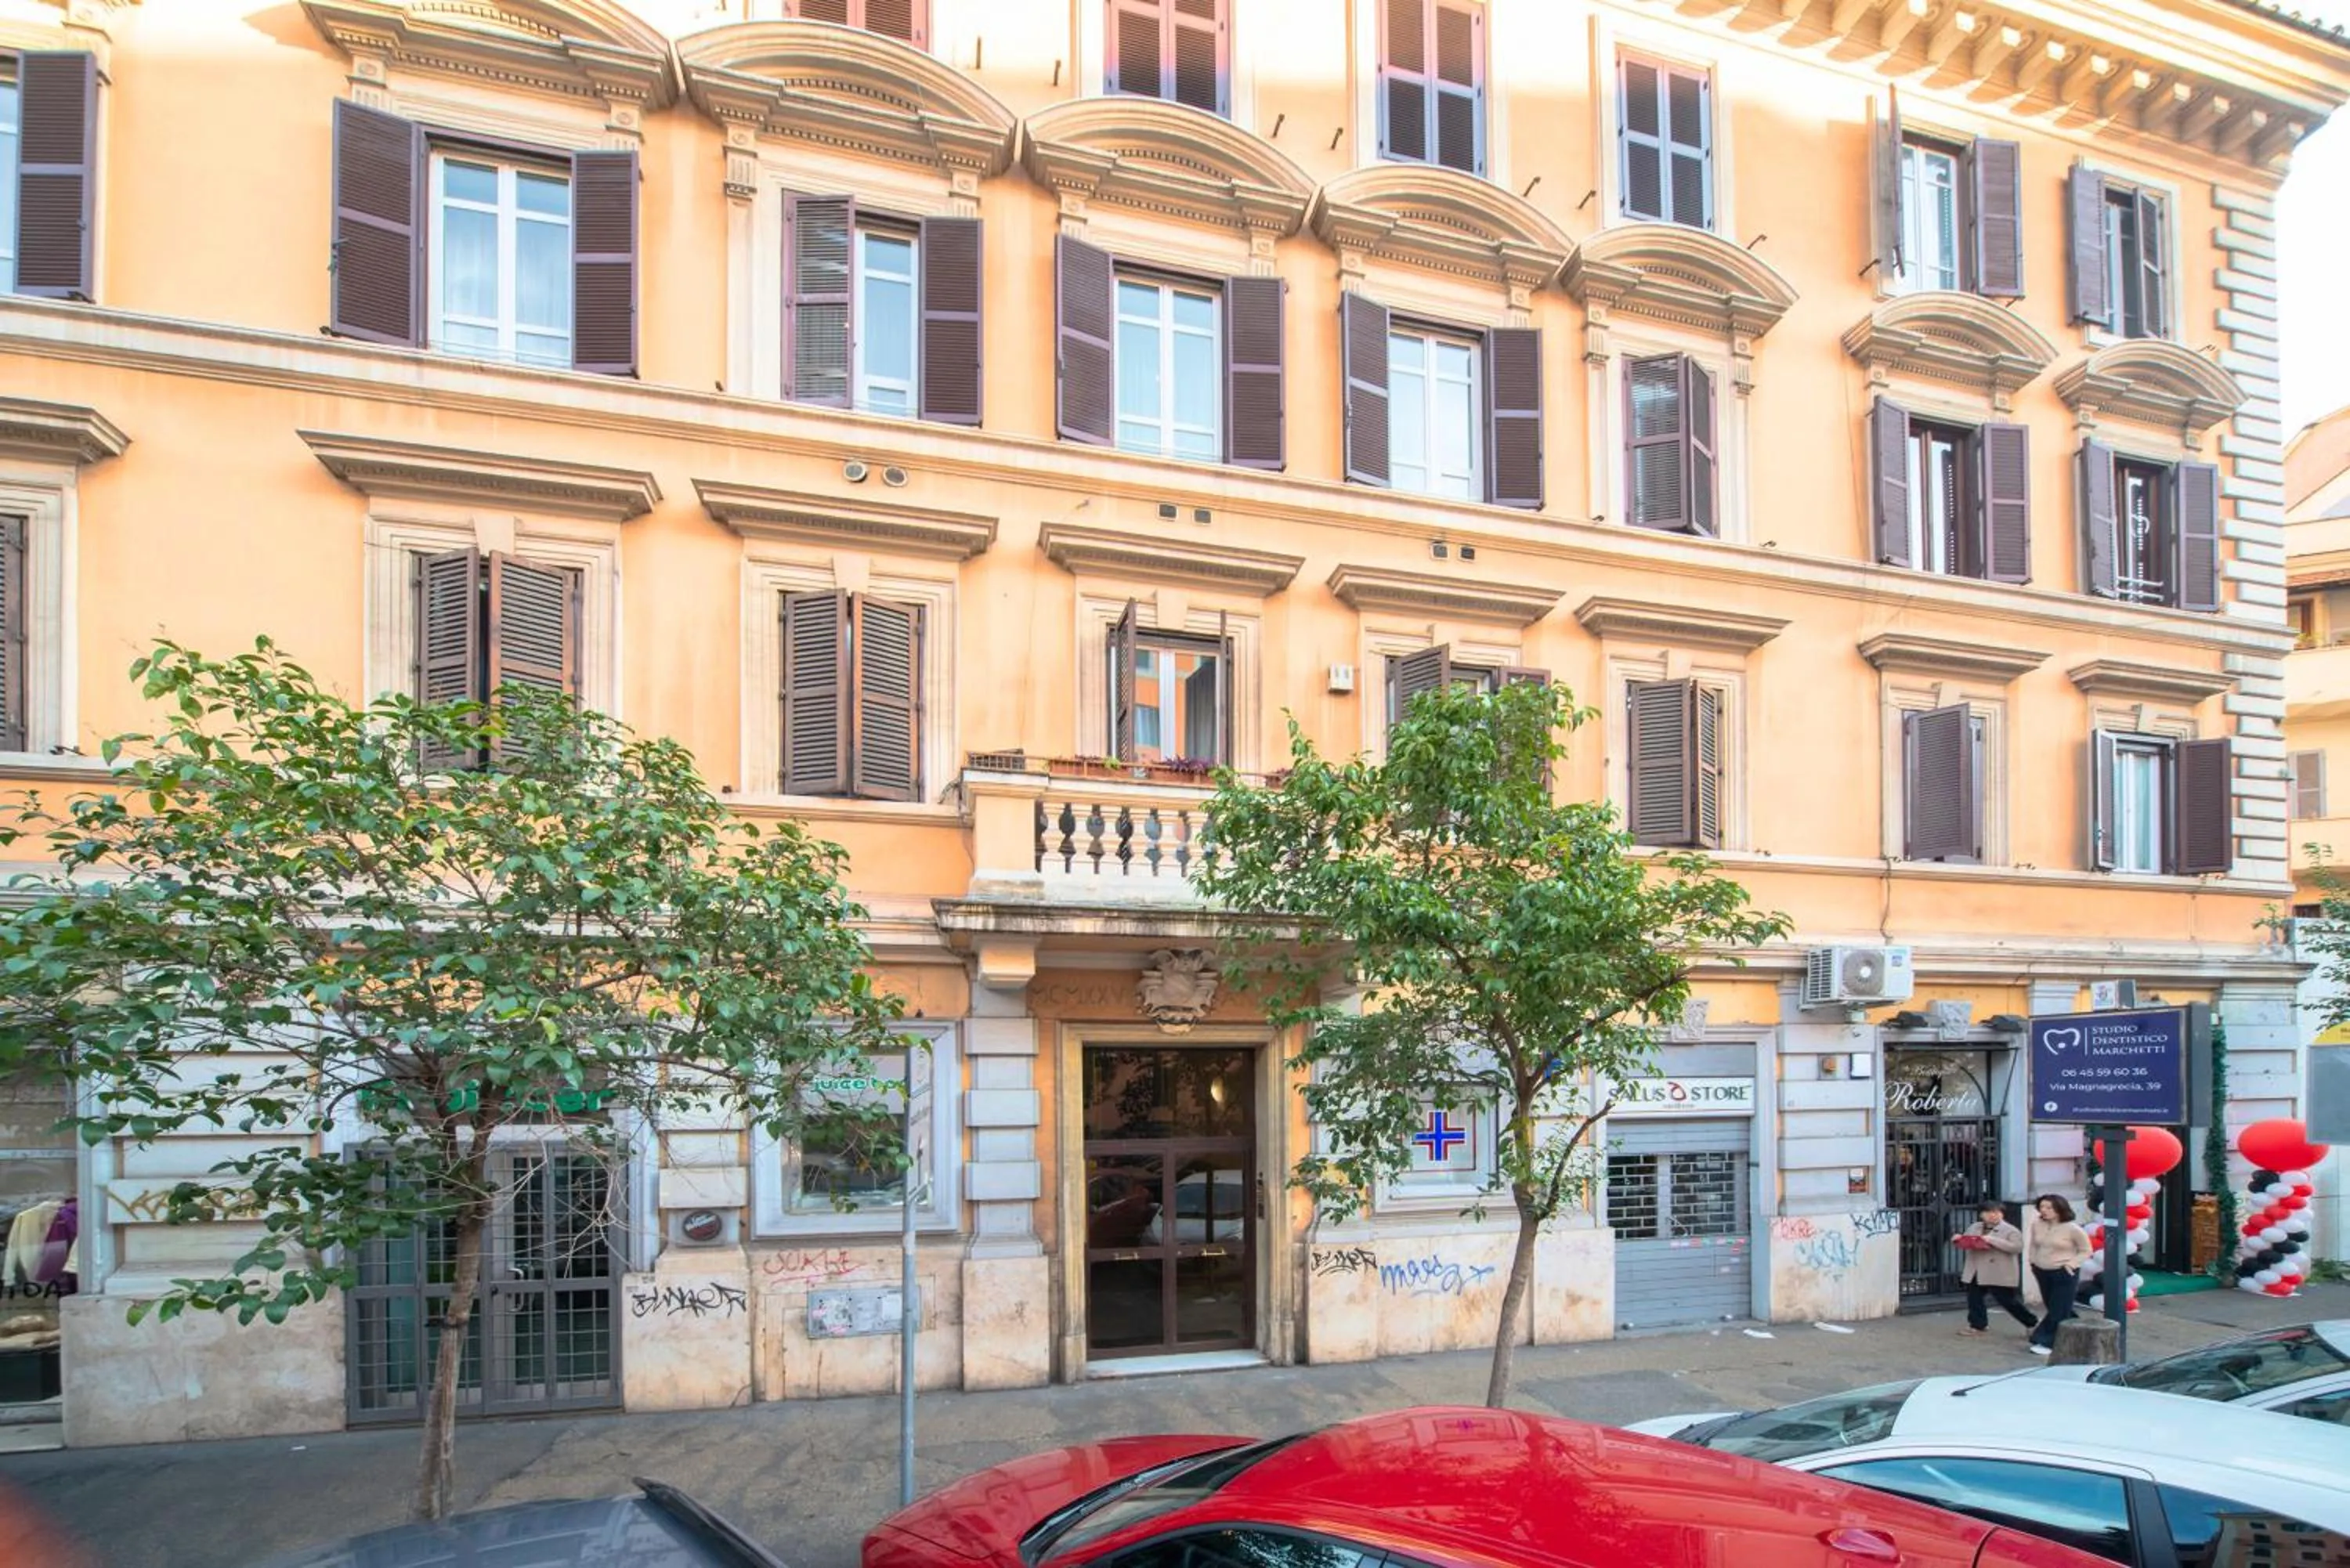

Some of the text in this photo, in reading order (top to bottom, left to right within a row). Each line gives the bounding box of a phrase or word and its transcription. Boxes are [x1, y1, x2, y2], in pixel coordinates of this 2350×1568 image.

[2092, 1024, 2138, 1035] STUDIO
[2092, 1035, 2168, 1045] DENTISTICO
[2092, 1046, 2165, 1056] MARCHETTI
[2062, 1068, 2077, 1077] 06
[2096, 1068, 2111, 1076] 59
[2114, 1068, 2130, 1076] 60
[2131, 1067, 2148, 1076] 36
[811, 1078, 867, 1093] juice
[2049, 1082, 2066, 1091] Via
[2146, 1082, 2162, 1090] 39
[1690, 1085, 1752, 1101] STORE
